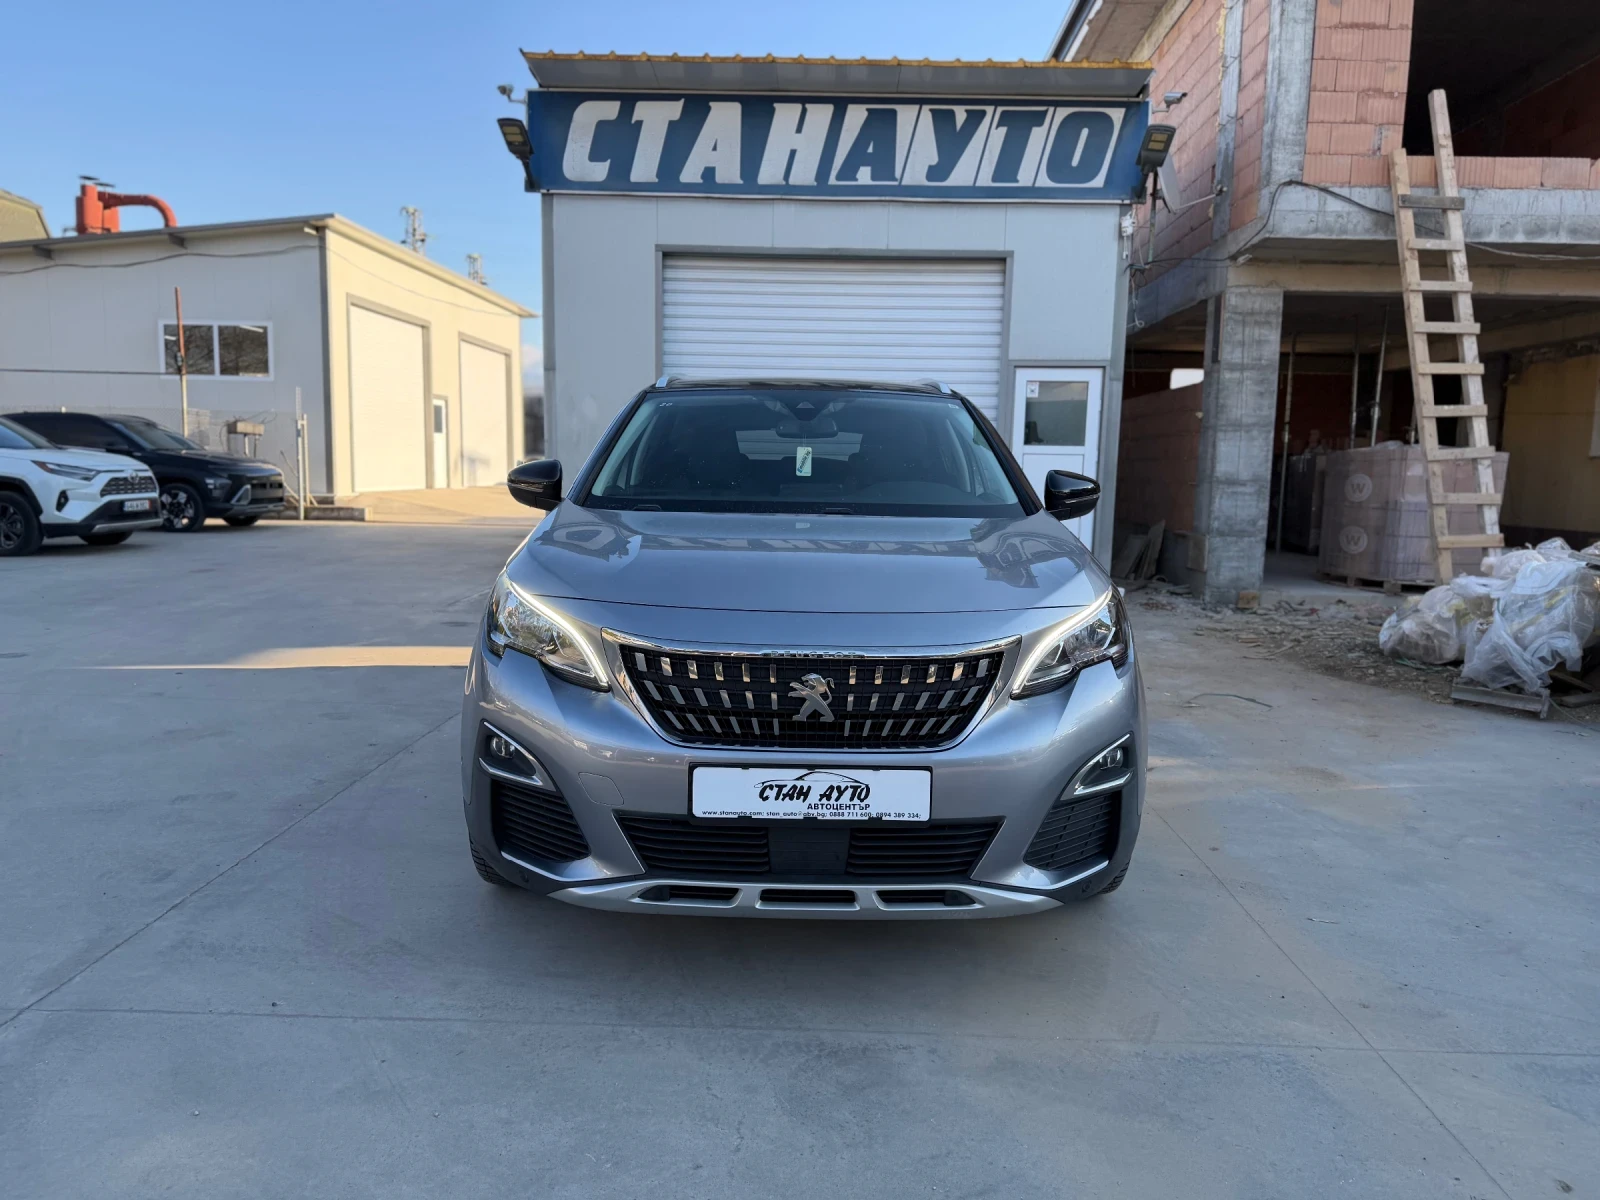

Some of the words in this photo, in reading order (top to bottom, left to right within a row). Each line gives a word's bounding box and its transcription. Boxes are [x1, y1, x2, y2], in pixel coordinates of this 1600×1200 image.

[759, 784, 811, 803] СТАН
[818, 784, 871, 803] АУТО
[807, 803, 871, 811] АВТОЦЕНТЪР
